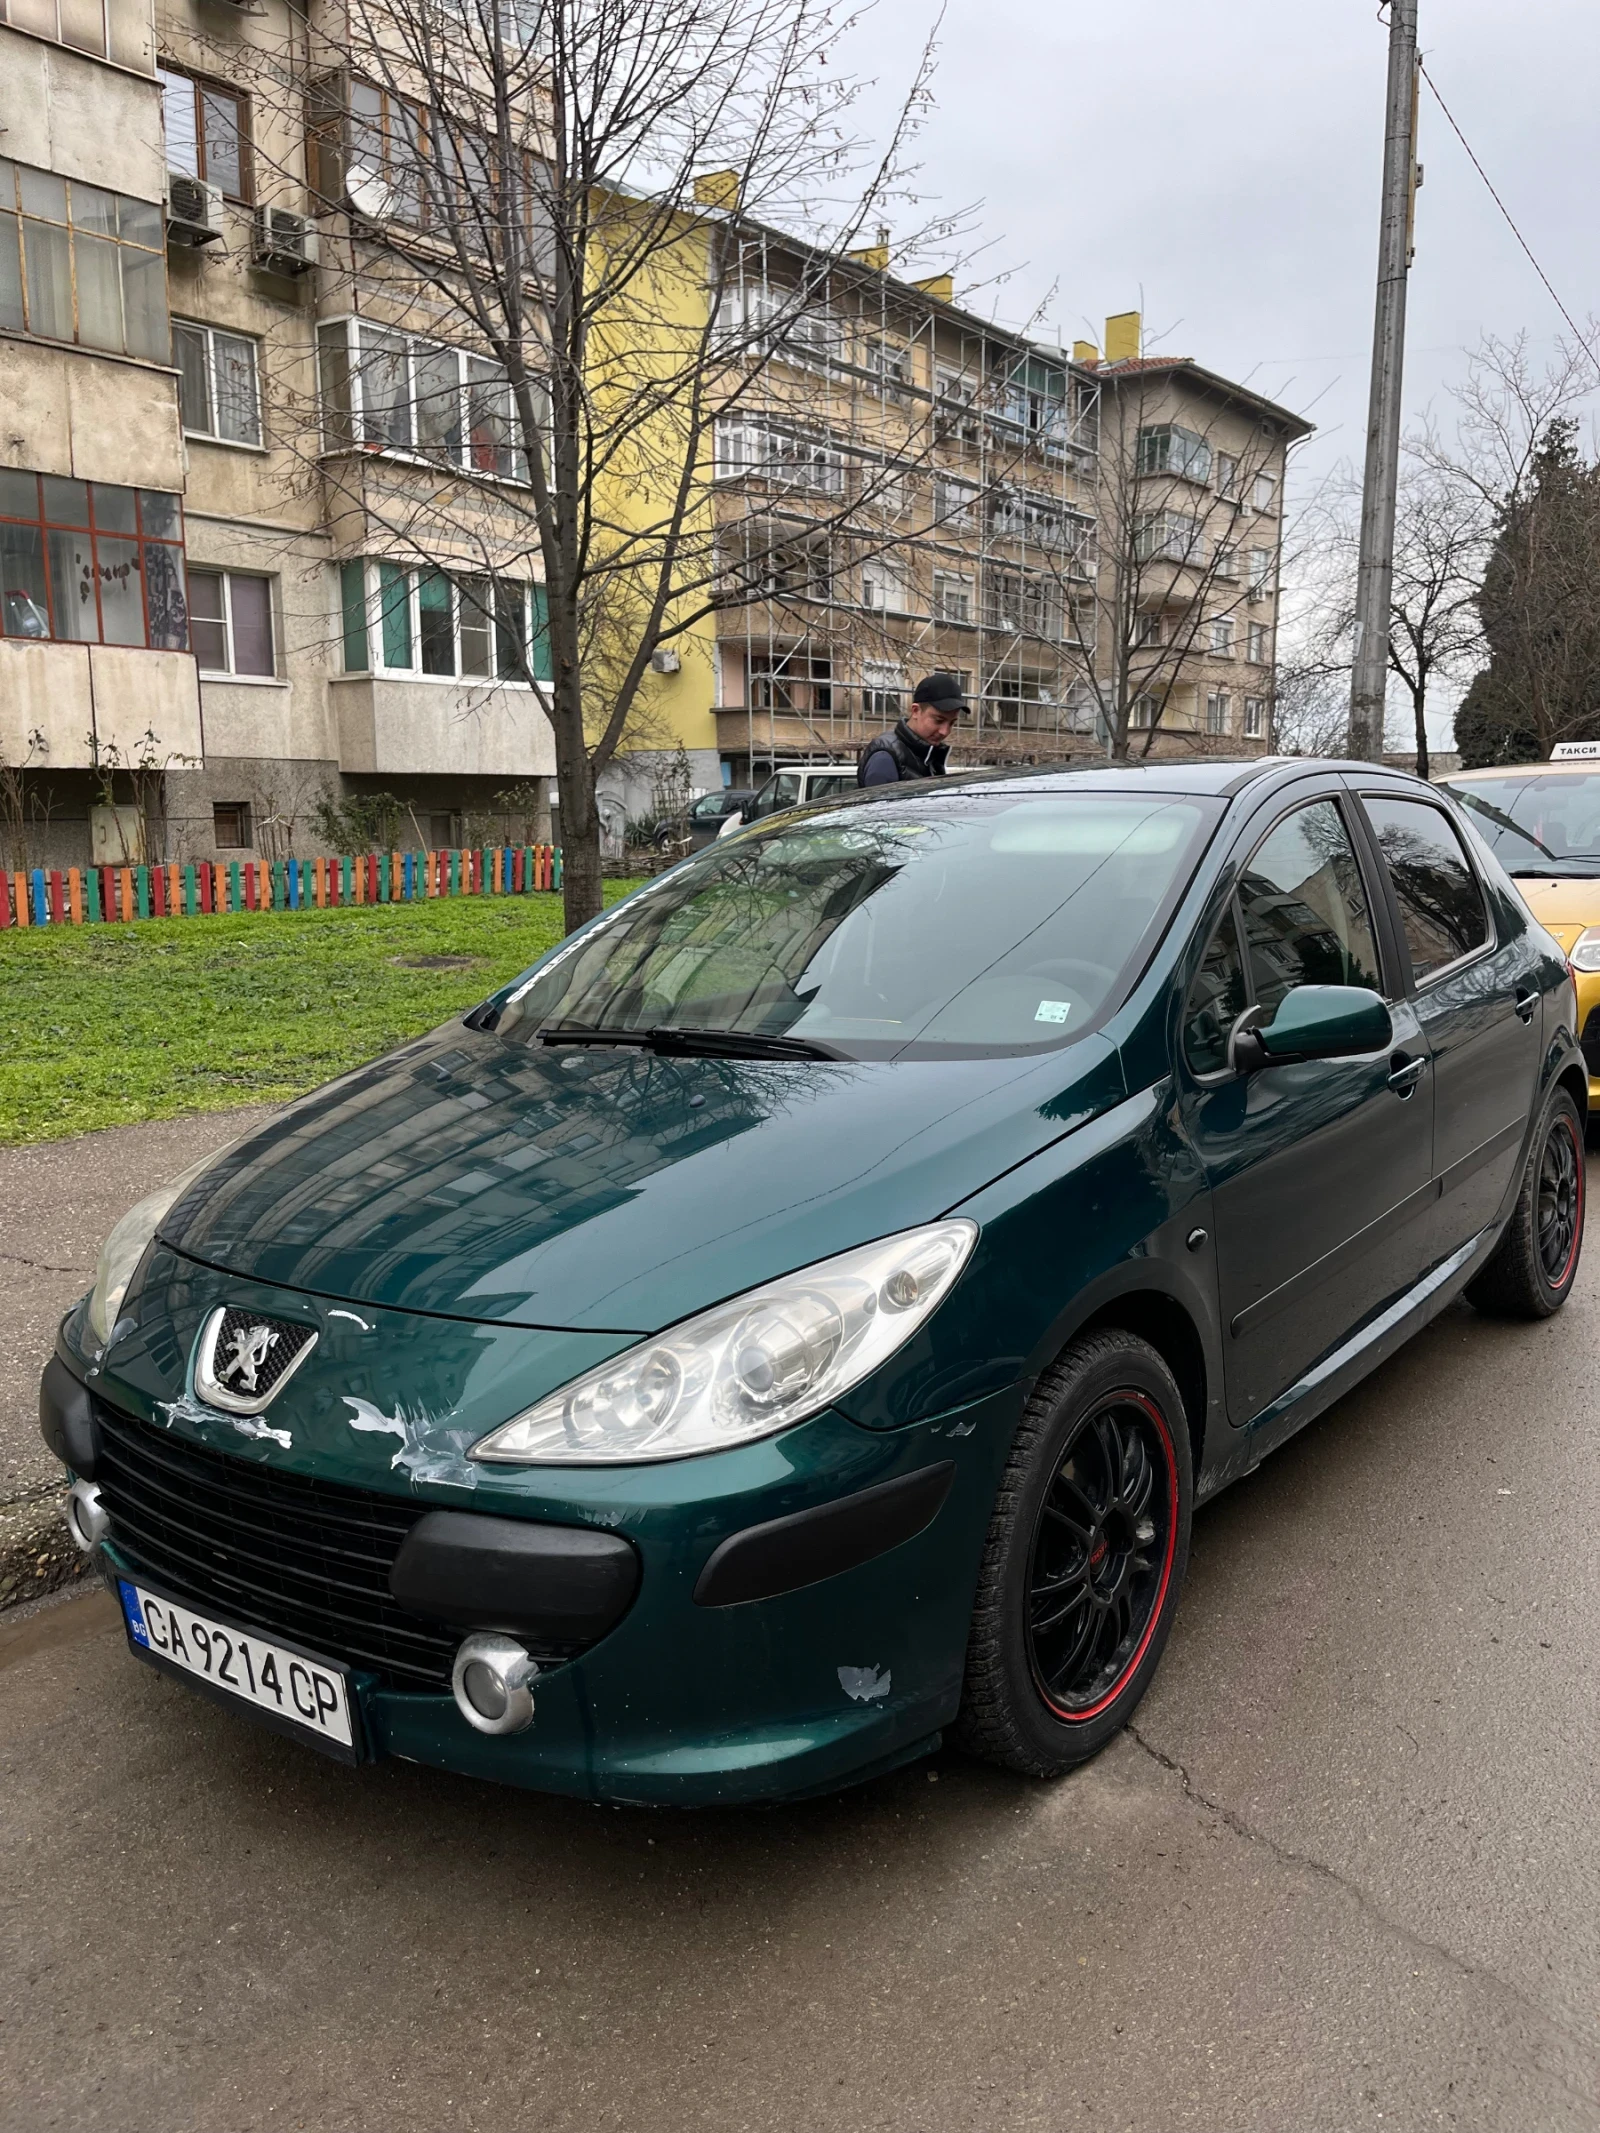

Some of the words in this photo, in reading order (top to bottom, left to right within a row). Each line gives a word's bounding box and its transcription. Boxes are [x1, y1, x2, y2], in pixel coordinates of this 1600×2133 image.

[1560, 747, 1596, 755] ТАКСИ
[132, 1618, 147, 1637] BG
[191, 1621, 284, 1706] 9214
